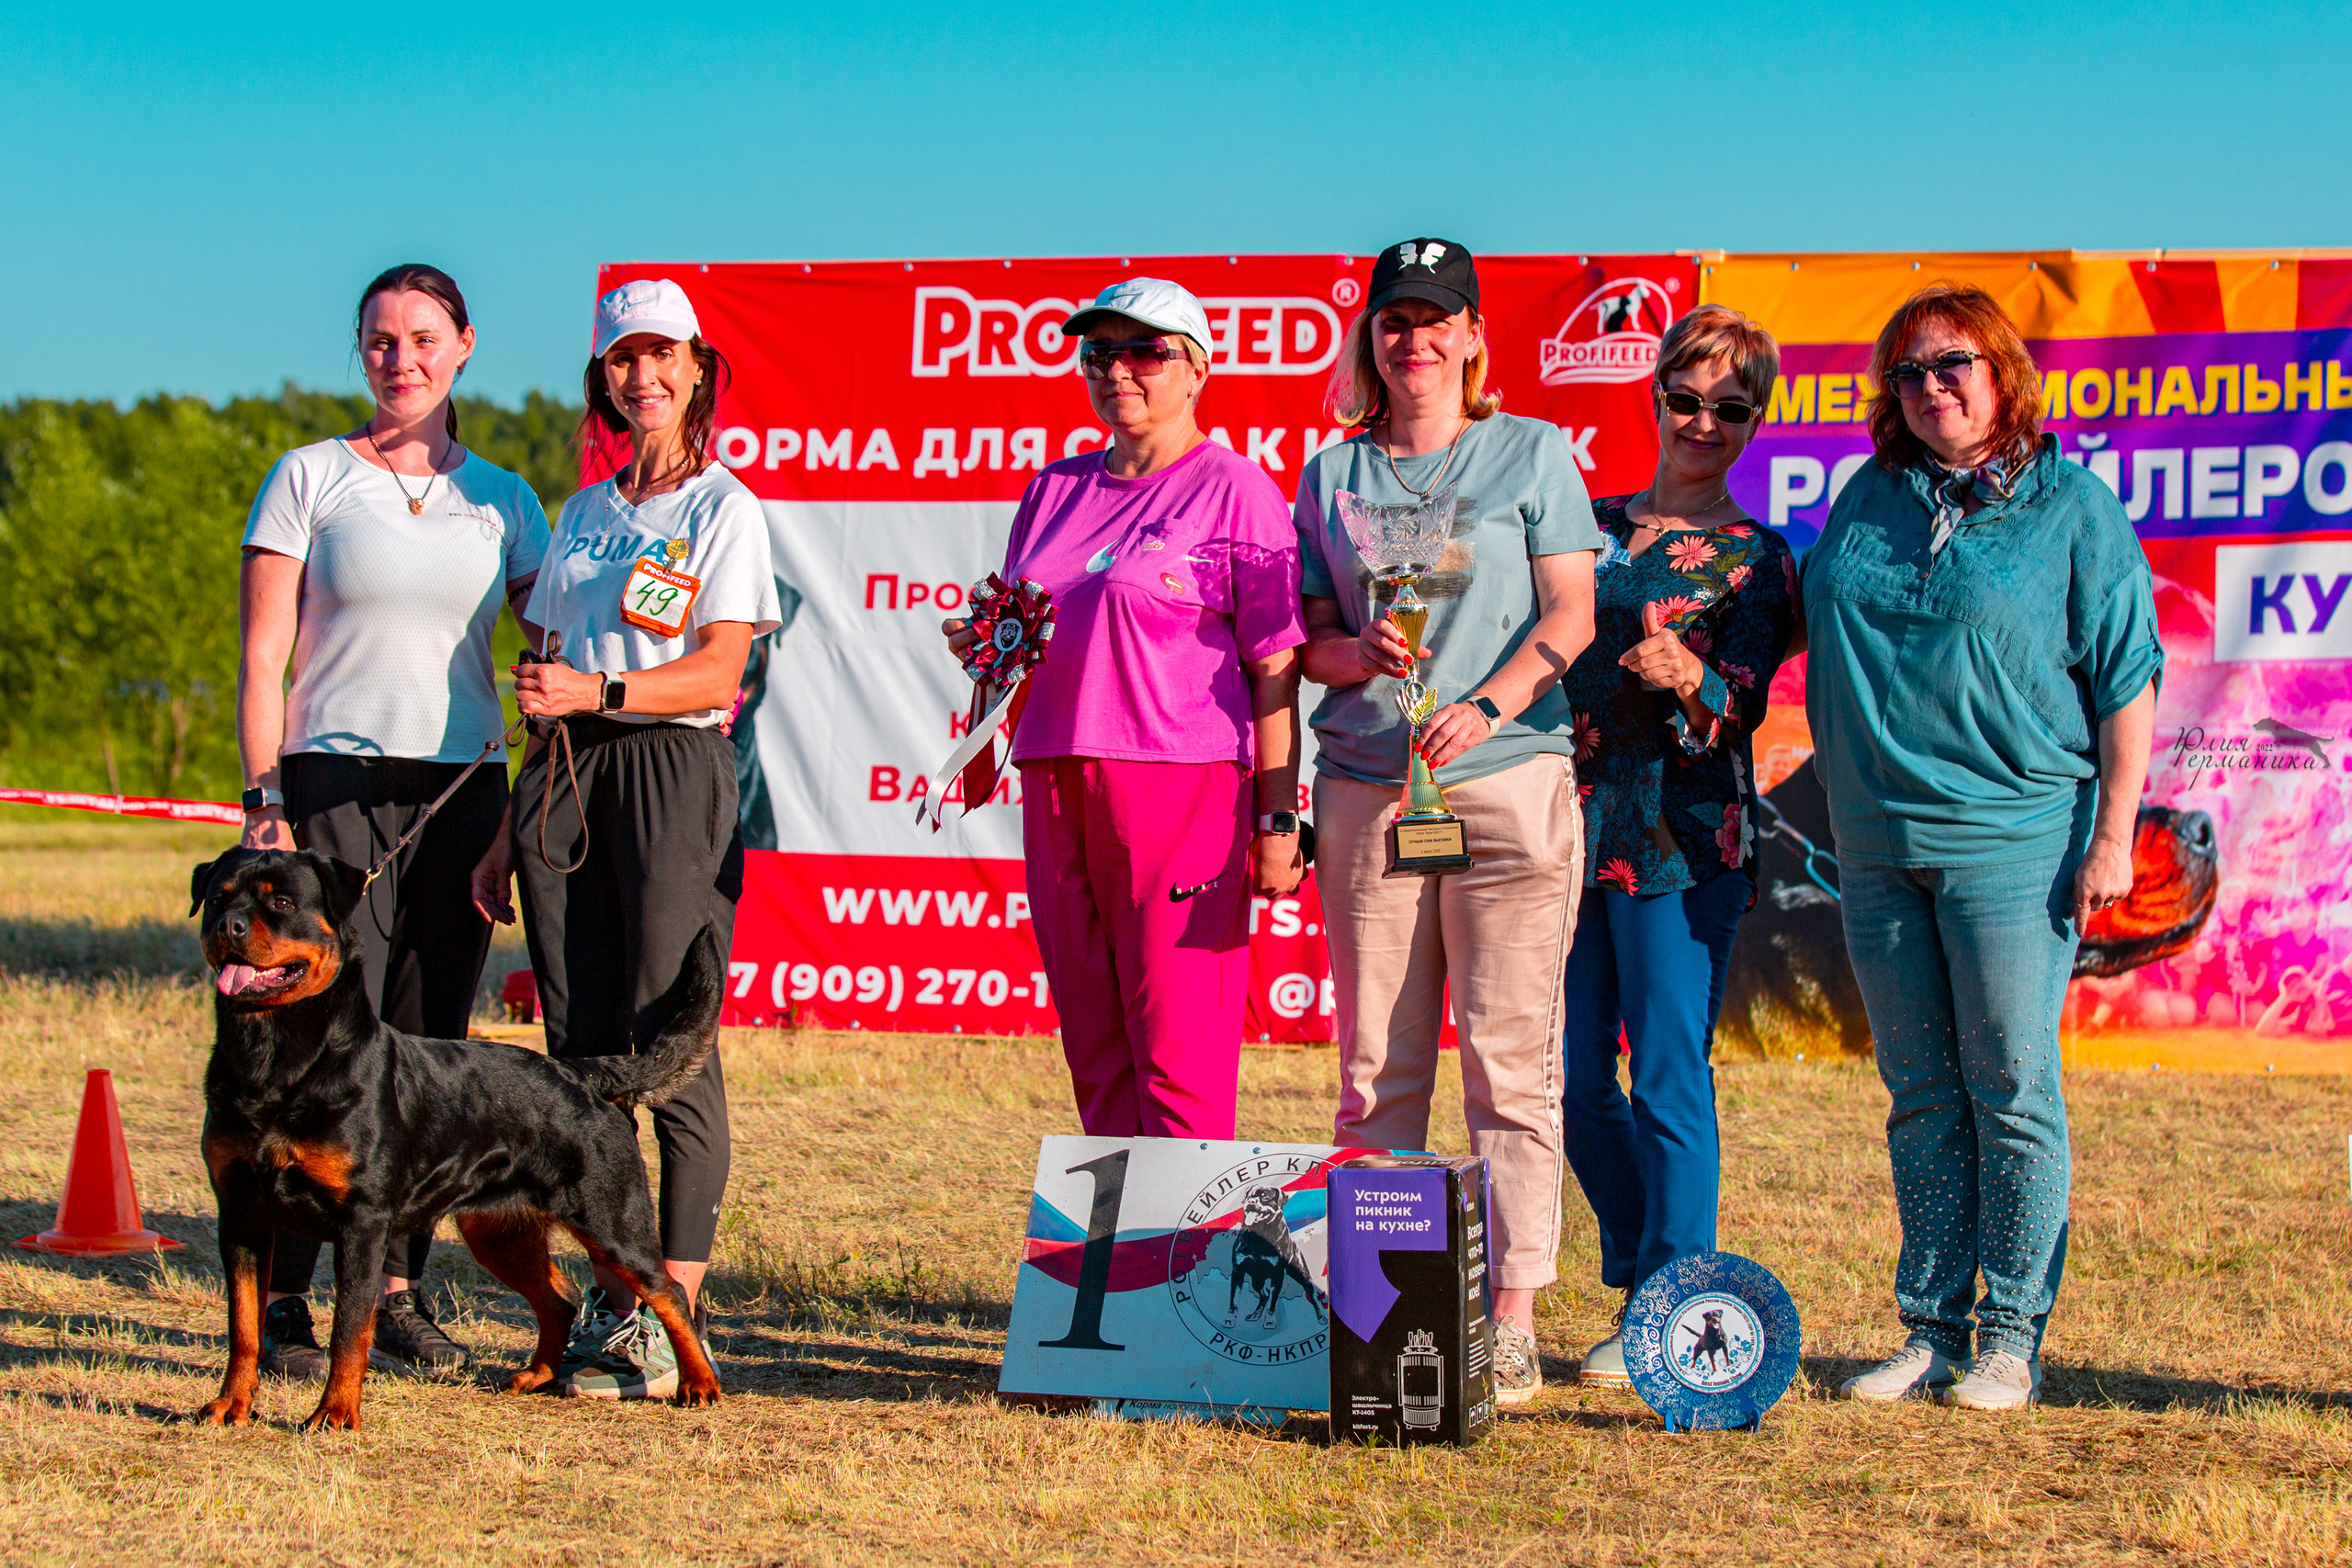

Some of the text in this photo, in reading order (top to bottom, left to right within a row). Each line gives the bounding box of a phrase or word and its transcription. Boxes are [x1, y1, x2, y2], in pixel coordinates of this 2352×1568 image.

[716, 426, 900, 470] ОРМА
[912, 428, 1047, 479] ДЛЯ
[563, 535, 666, 563] PUMA
[636, 580, 679, 615] 49
[1176, 881, 1218, 895] NIKE
[772, 962, 904, 1011] (909)
[1354, 1190, 1422, 1203] Устроим
[1355, 1206, 1412, 1216] пикник
[1173, 1160, 1270, 1303] РОТВЕЙЛЕР
[1356, 1220, 1430, 1234] на кухне?
[1467, 1222, 1483, 1240] Всегда
[1038, 1149, 1130, 1351] 1
[1129, 1400, 1162, 1410] Корма
[1163, 1402, 1196, 1412] нового
